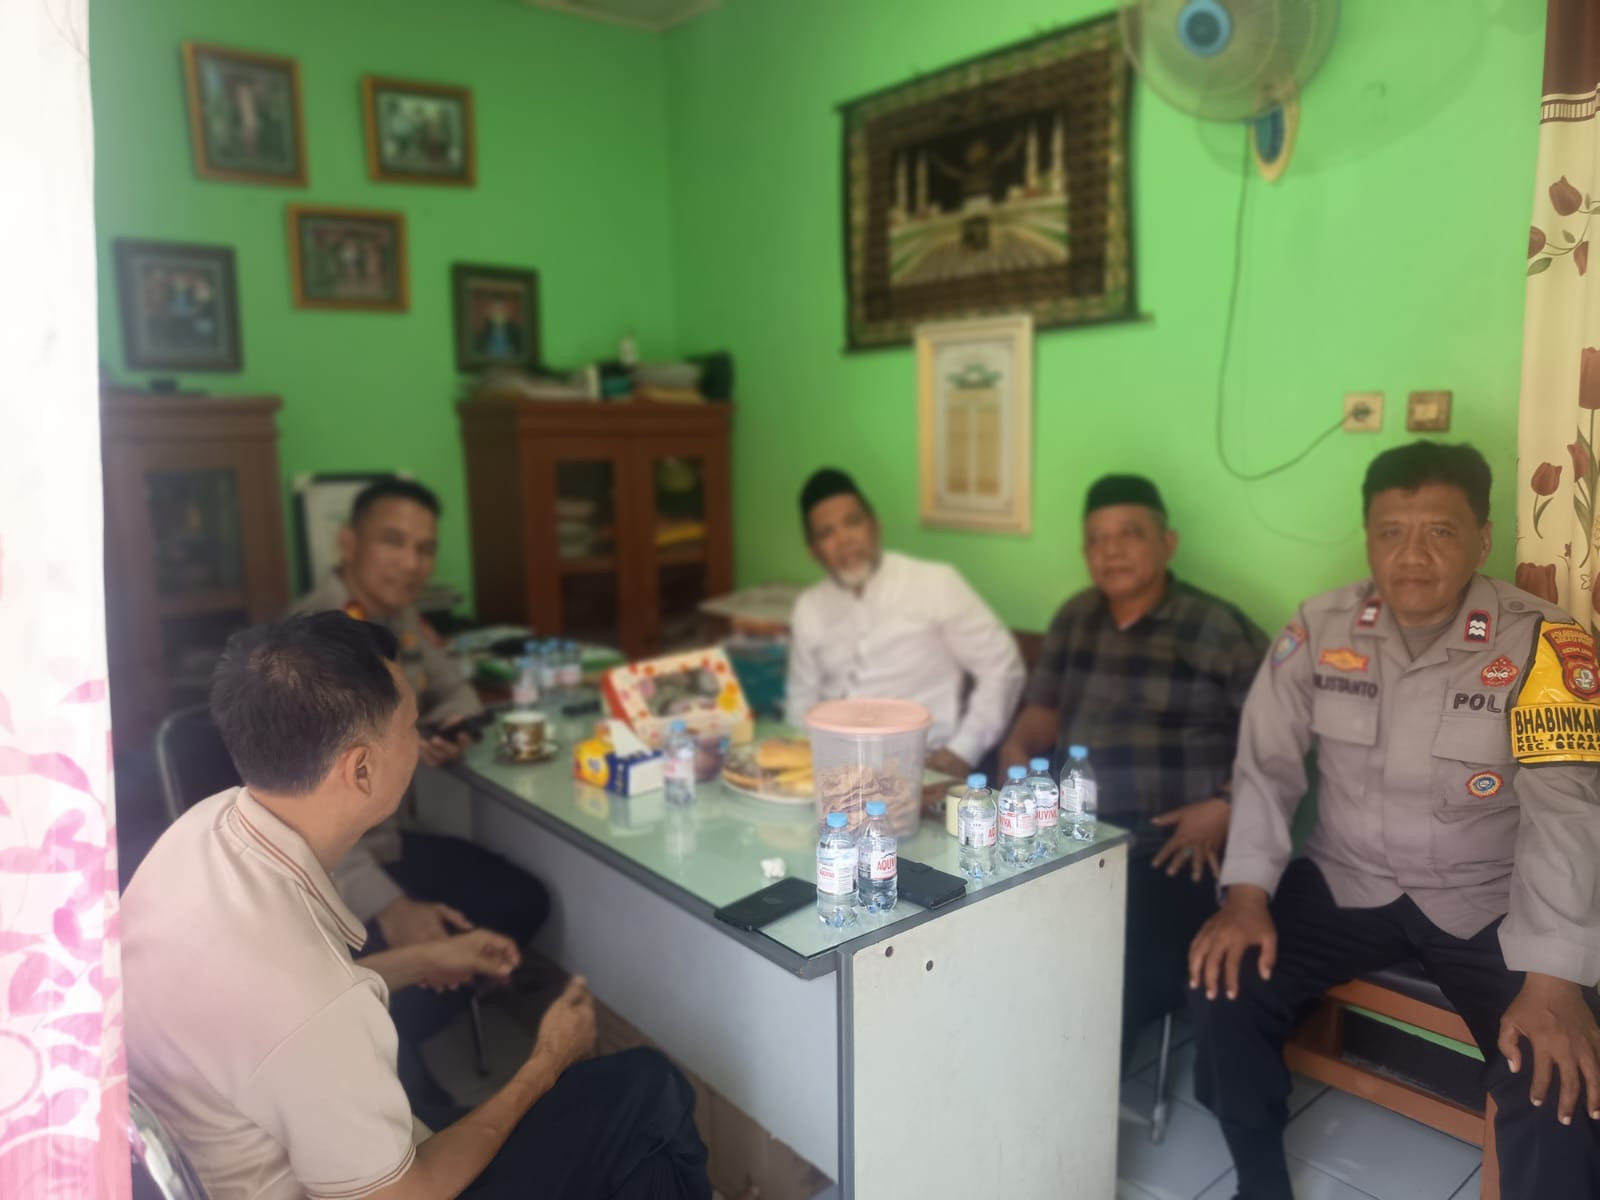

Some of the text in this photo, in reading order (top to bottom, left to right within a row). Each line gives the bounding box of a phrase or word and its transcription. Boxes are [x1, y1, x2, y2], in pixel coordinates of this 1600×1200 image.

[1453, 693, 1507, 713] POL
[1516, 735, 1544, 744] KEL.
[1517, 743, 1549, 752] KEC.
